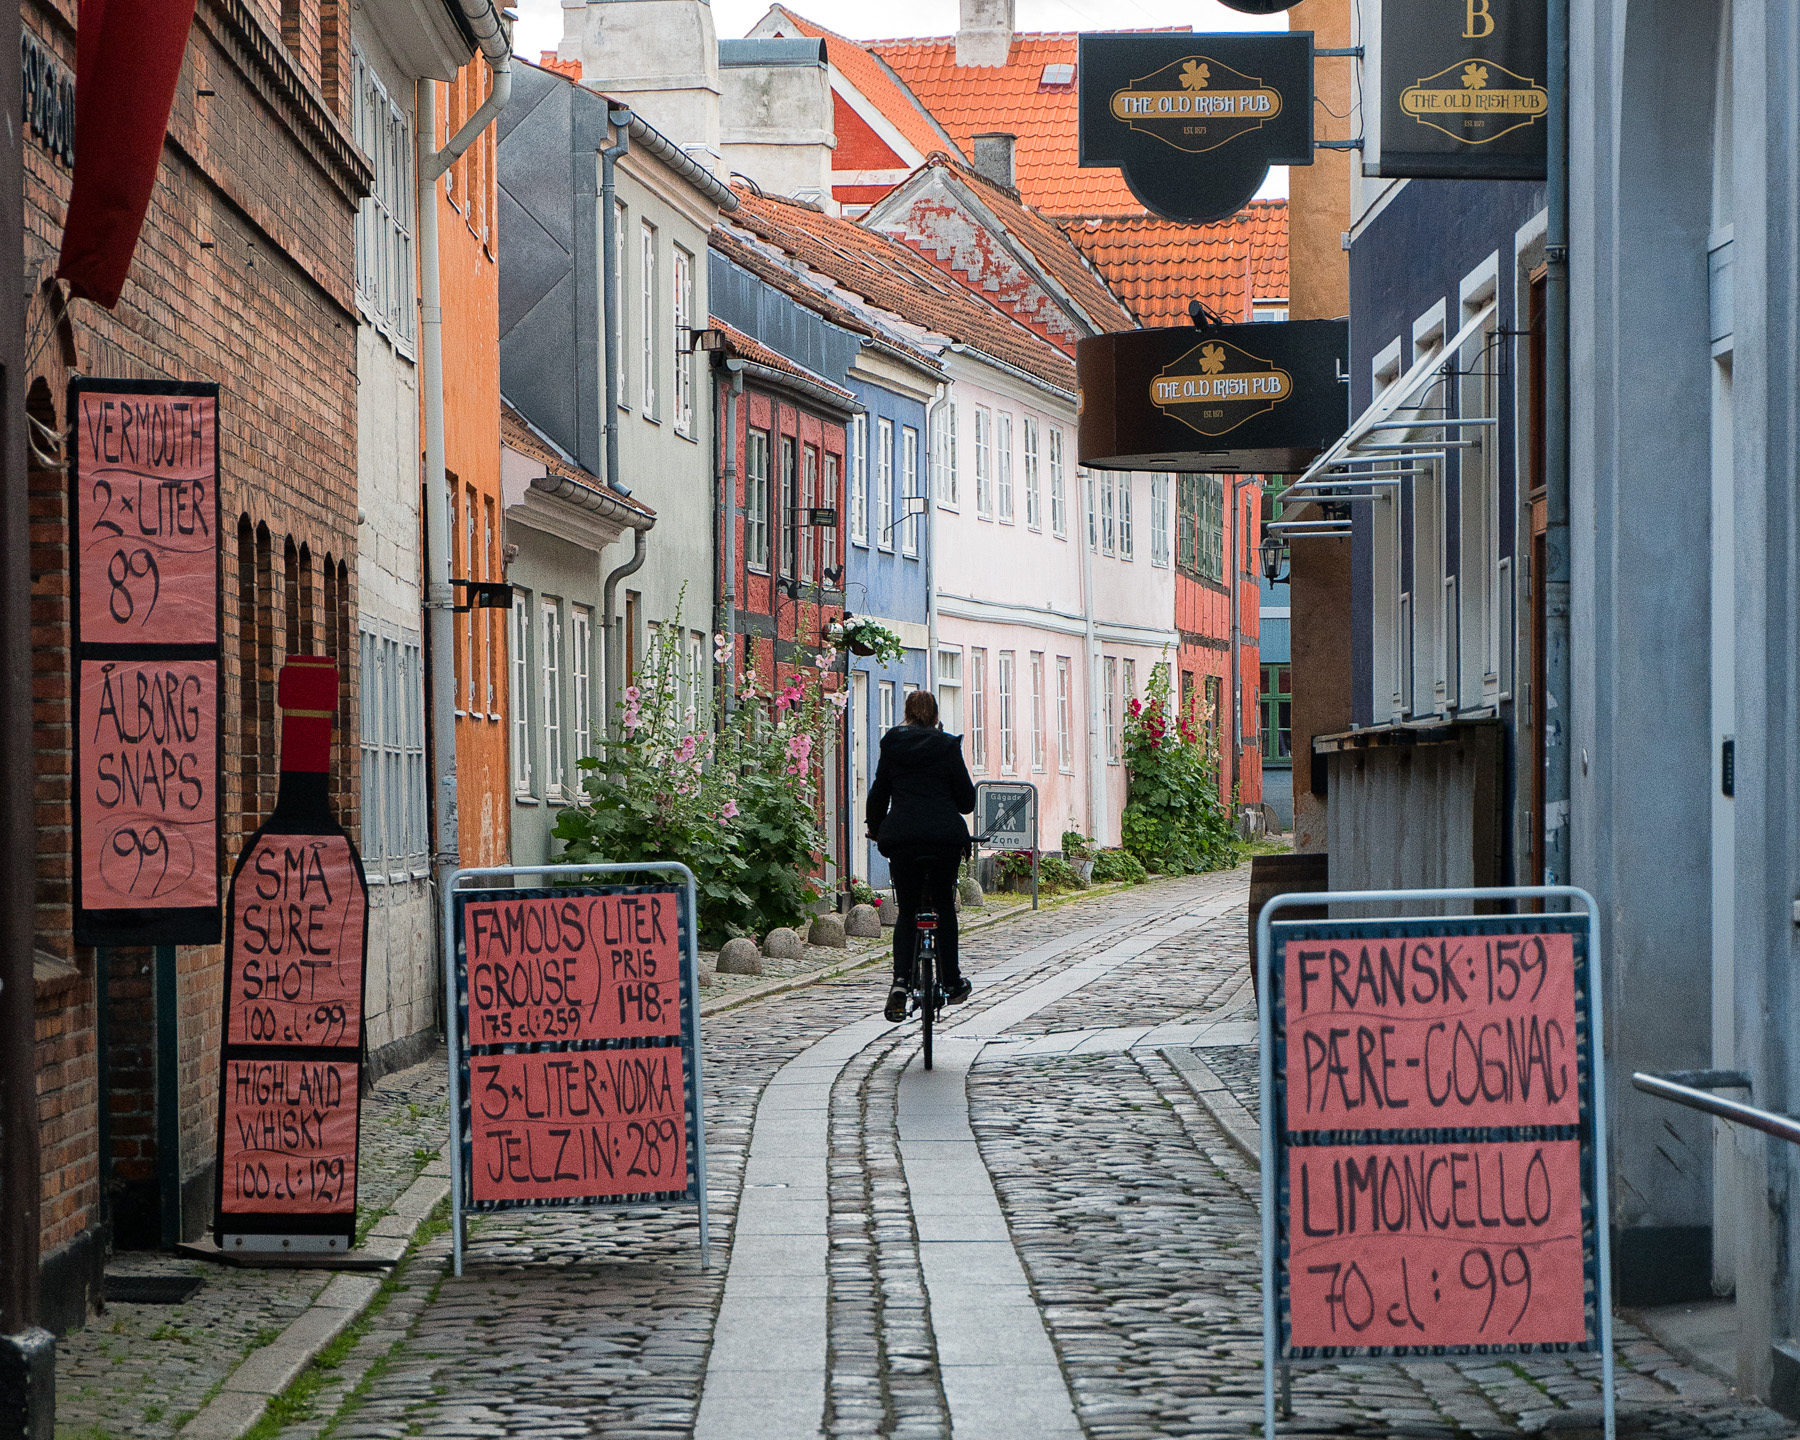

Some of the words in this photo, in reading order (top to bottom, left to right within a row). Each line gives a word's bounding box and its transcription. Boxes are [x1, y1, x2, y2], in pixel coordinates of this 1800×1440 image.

[1462, 0, 1495, 38] B
[1121, 96, 1155, 114] THE
[1158, 96, 1191, 113] OLD
[1195, 95, 1236, 116] IRISH
[1239, 95, 1271, 112] PUB
[1412, 94, 1440, 109] THE
[1444, 94, 1472, 108] OLD
[1475, 94, 1509, 110] IRISH
[1513, 94, 1540, 108] PUB
[1156, 382, 1181, 399] THE
[1183, 379, 1210, 397] OLD
[1213, 378, 1248, 399] IRISH
[1252, 377, 1282, 394] PUB
[84, 400, 203, 468] VERMOUTH
[107, 548, 160, 628] 89
[94, 662, 201, 746] ÅLBORG
[96, 747, 203, 813] SNAPS
[112, 825, 169, 897] 99
[992, 835, 1020, 845] Zone
[255, 841, 332, 904] SMÅ
[243, 903, 331, 955] SURE
[472, 901, 586, 959] FAMOUS
[602, 897, 667, 945] LITER
[243, 958, 332, 1001] SHOT
[474, 958, 582, 1010] GROUSE
[611, 949, 657, 980] PRIS
[244, 1006, 276, 1042] 100
[481, 1012, 512, 1040] 175
[235, 1062, 341, 1108] HIGHLAND
[1303, 1014, 1567, 1113] PÆRE-COGNAC
[236, 1109, 330, 1150] WHISKY
[236, 1162, 270, 1200] 100
[1302, 1148, 1551, 1237] LIMONCELLO
[1307, 1260, 1375, 1332] 70
[1460, 1245, 1532, 1335] 99
